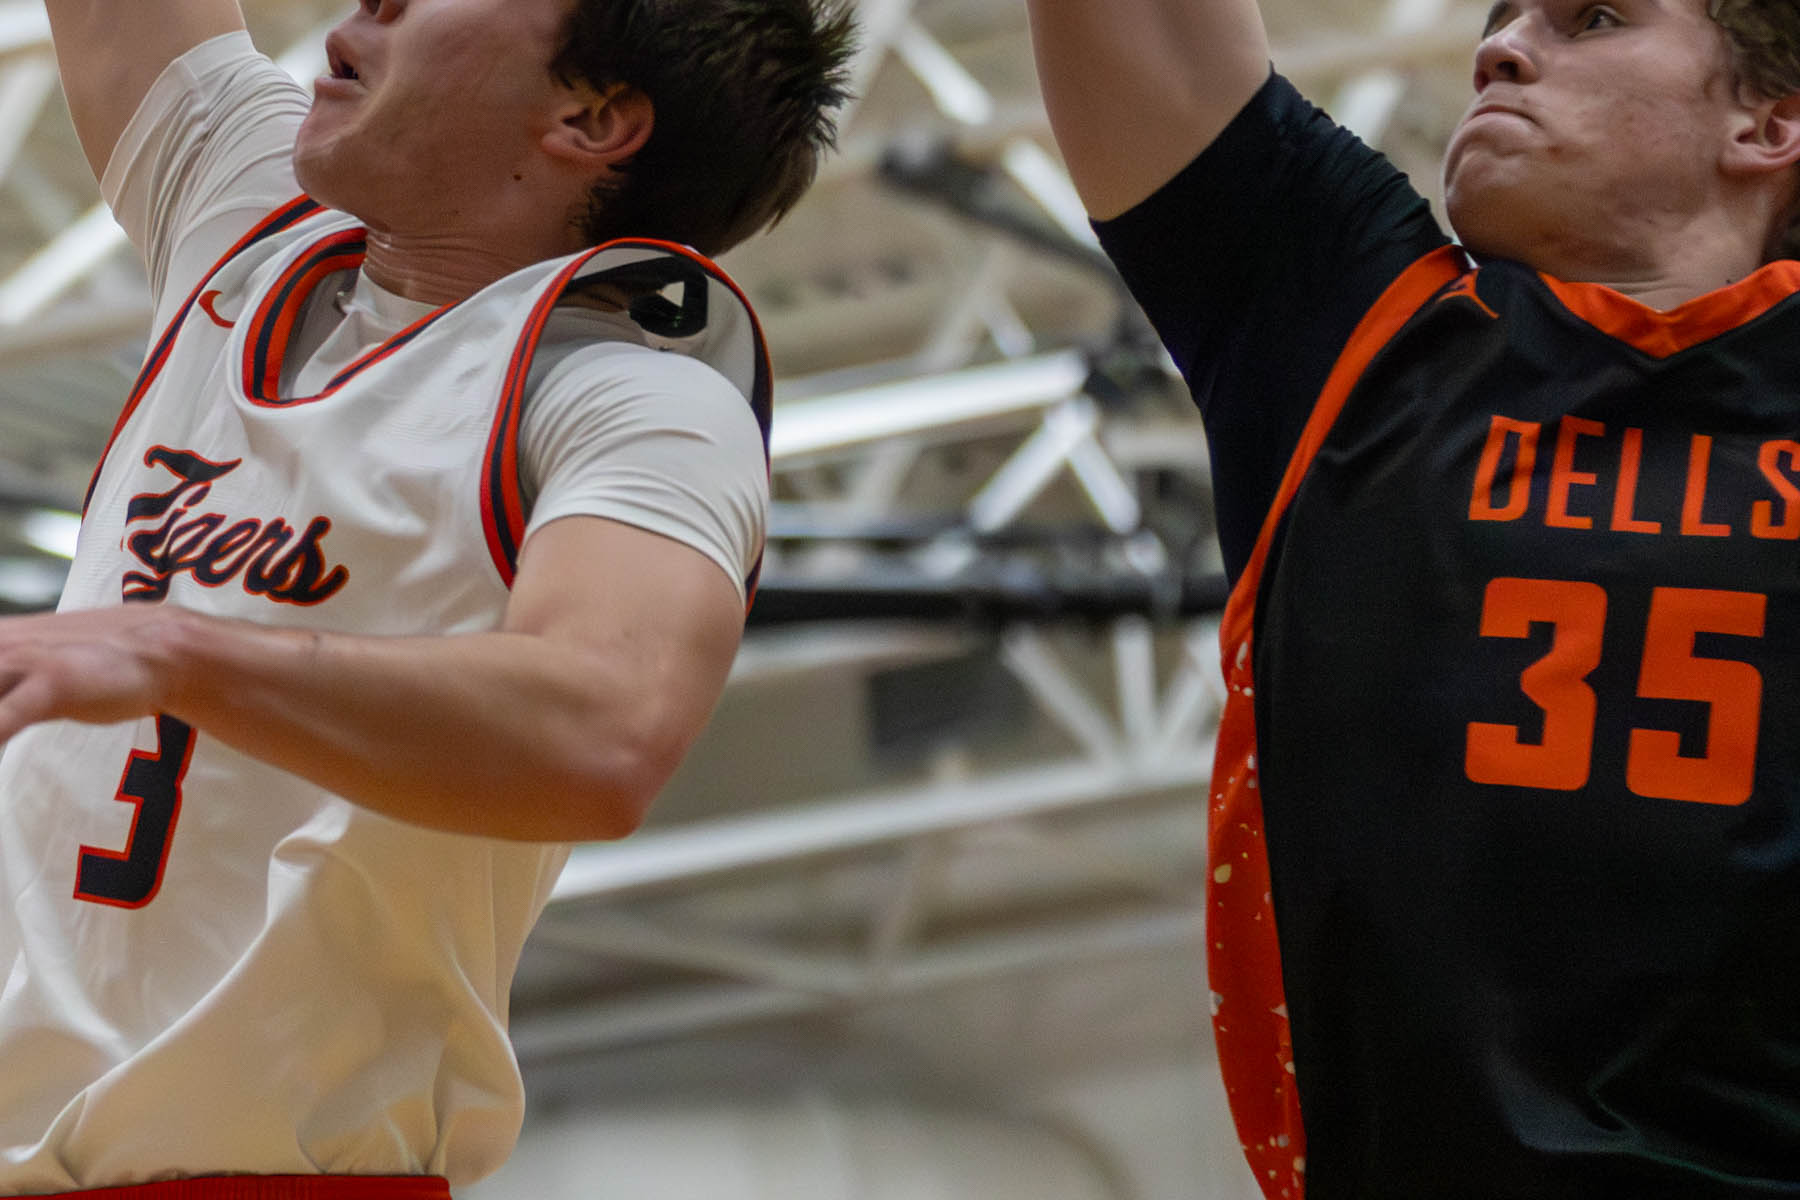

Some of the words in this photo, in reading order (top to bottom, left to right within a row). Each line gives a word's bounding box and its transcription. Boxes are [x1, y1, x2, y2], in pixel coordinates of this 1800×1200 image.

[120, 445, 350, 607] Tigers
[1468, 414, 1800, 540] DELLS
[1465, 576, 1767, 806] 35
[73, 711, 198, 910] 3
